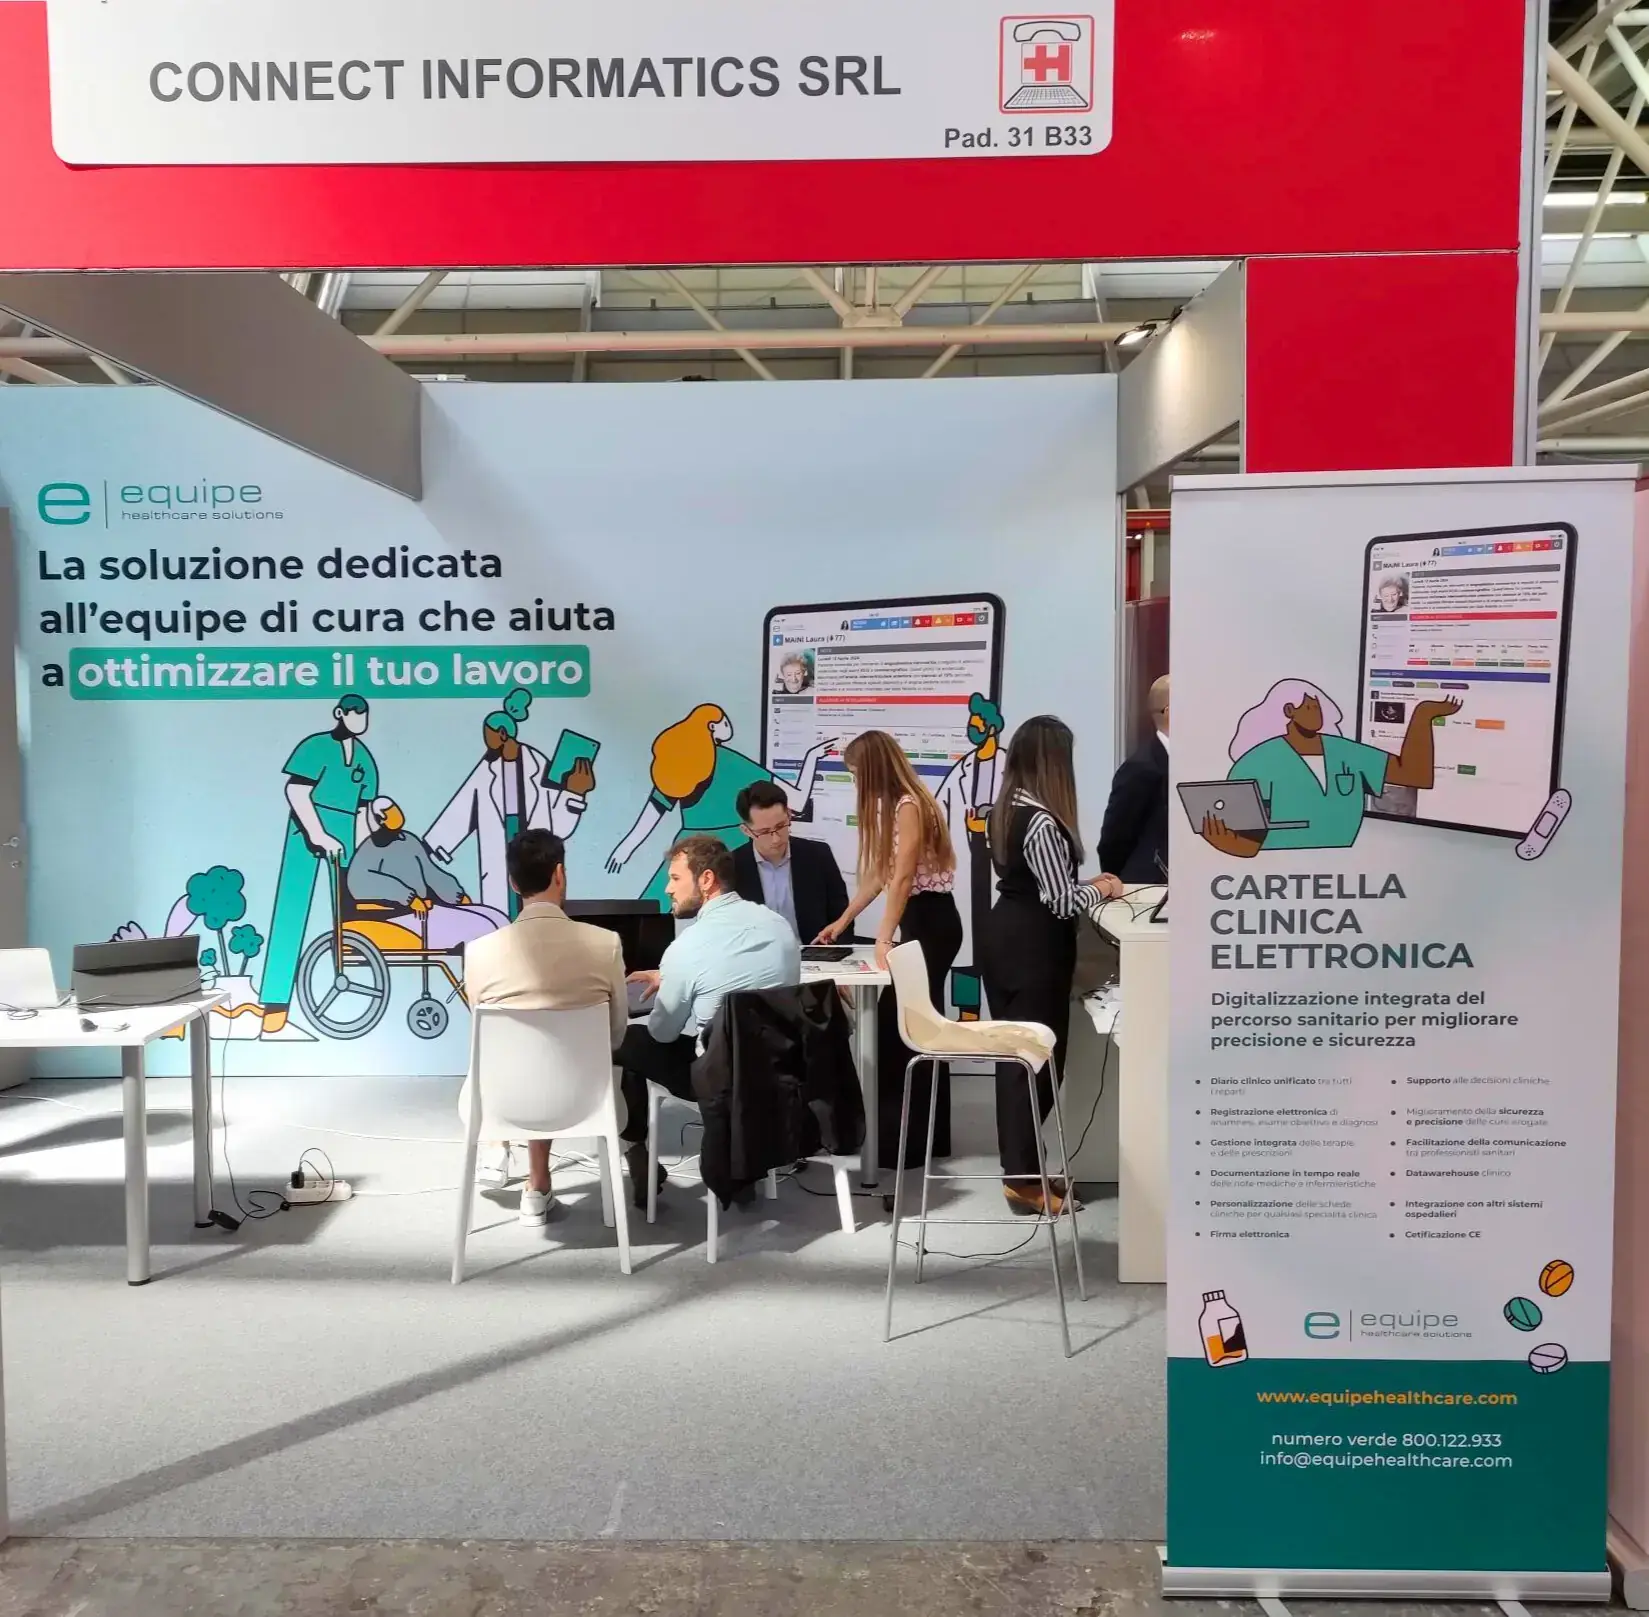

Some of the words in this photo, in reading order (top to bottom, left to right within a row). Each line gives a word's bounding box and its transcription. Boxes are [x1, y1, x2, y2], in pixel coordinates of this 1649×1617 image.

[149, 59, 405, 102] CONNECT
[422, 57, 780, 99] INFORMATICS
[798, 55, 902, 97] SRL
[944, 128, 998, 148] Pad.
[1008, 126, 1033, 147] 31
[1045, 126, 1092, 146] B33
[120, 478, 262, 509] equipe
[122, 510, 207, 520] healthcare
[212, 510, 283, 520] solutions
[38, 550, 86, 580] La
[99, 547, 304, 580] soluzione
[317, 545, 502, 579] dedicata
[39, 600, 247, 641] all'equipe
[260, 599, 298, 634] di
[312, 606, 405, 632] cura
[418, 599, 496, 631] che
[508, 597, 616, 631] aiuta
[41, 662, 65, 687] a
[77, 653, 321, 688] ottimizzare
[331, 652, 355, 686] il
[366, 656, 440, 686] tuo
[452, 652, 583, 685] lavoro
[1211, 873, 1407, 900] CARTELLA
[1210, 908, 1363, 934] CLINICA
[1211, 943, 1474, 969] ELETTRONICA
[1211, 991, 1358, 1009] Digitalizzazione
[1365, 991, 1450, 1008] integrata
[1456, 991, 1485, 1004] del
[1211, 1014, 1292, 1029] percorso
[1298, 1012, 1379, 1026] sanitario
[1385, 1014, 1416, 1029] per
[1422, 1011, 1518, 1028] migliorare
[1211, 1033, 1306, 1049] precisione
[1312, 1036, 1323, 1047] e
[1329, 1033, 1415, 1047] sicurezza
[1406, 1077, 1450, 1085] Supporto
[1211, 1109, 1274, 1117] Registrazione
[1499, 1108, 1544, 1116] sicurezza
[1415, 1118, 1463, 1127] precisione
[1254, 1139, 1297, 1148] integrata
[1493, 1139, 1566, 1147] comunicazione
[1304, 1171, 1334, 1179] tempo
[1211, 1200, 1293, 1208] Personalizzazione
[1406, 1201, 1464, 1209] Integrazione
[1406, 1211, 1457, 1219] ospedalieri
[1361, 1310, 1458, 1330] equipe
[1257, 1390, 1518, 1407] www.equipehealthcare.com
[1272, 1434, 1342, 1446] numero
[1347, 1433, 1397, 1446] verde
[1403, 1434, 1501, 1447] 800.122.933
[1261, 1451, 1512, 1469] info@equipehealthcare.com
